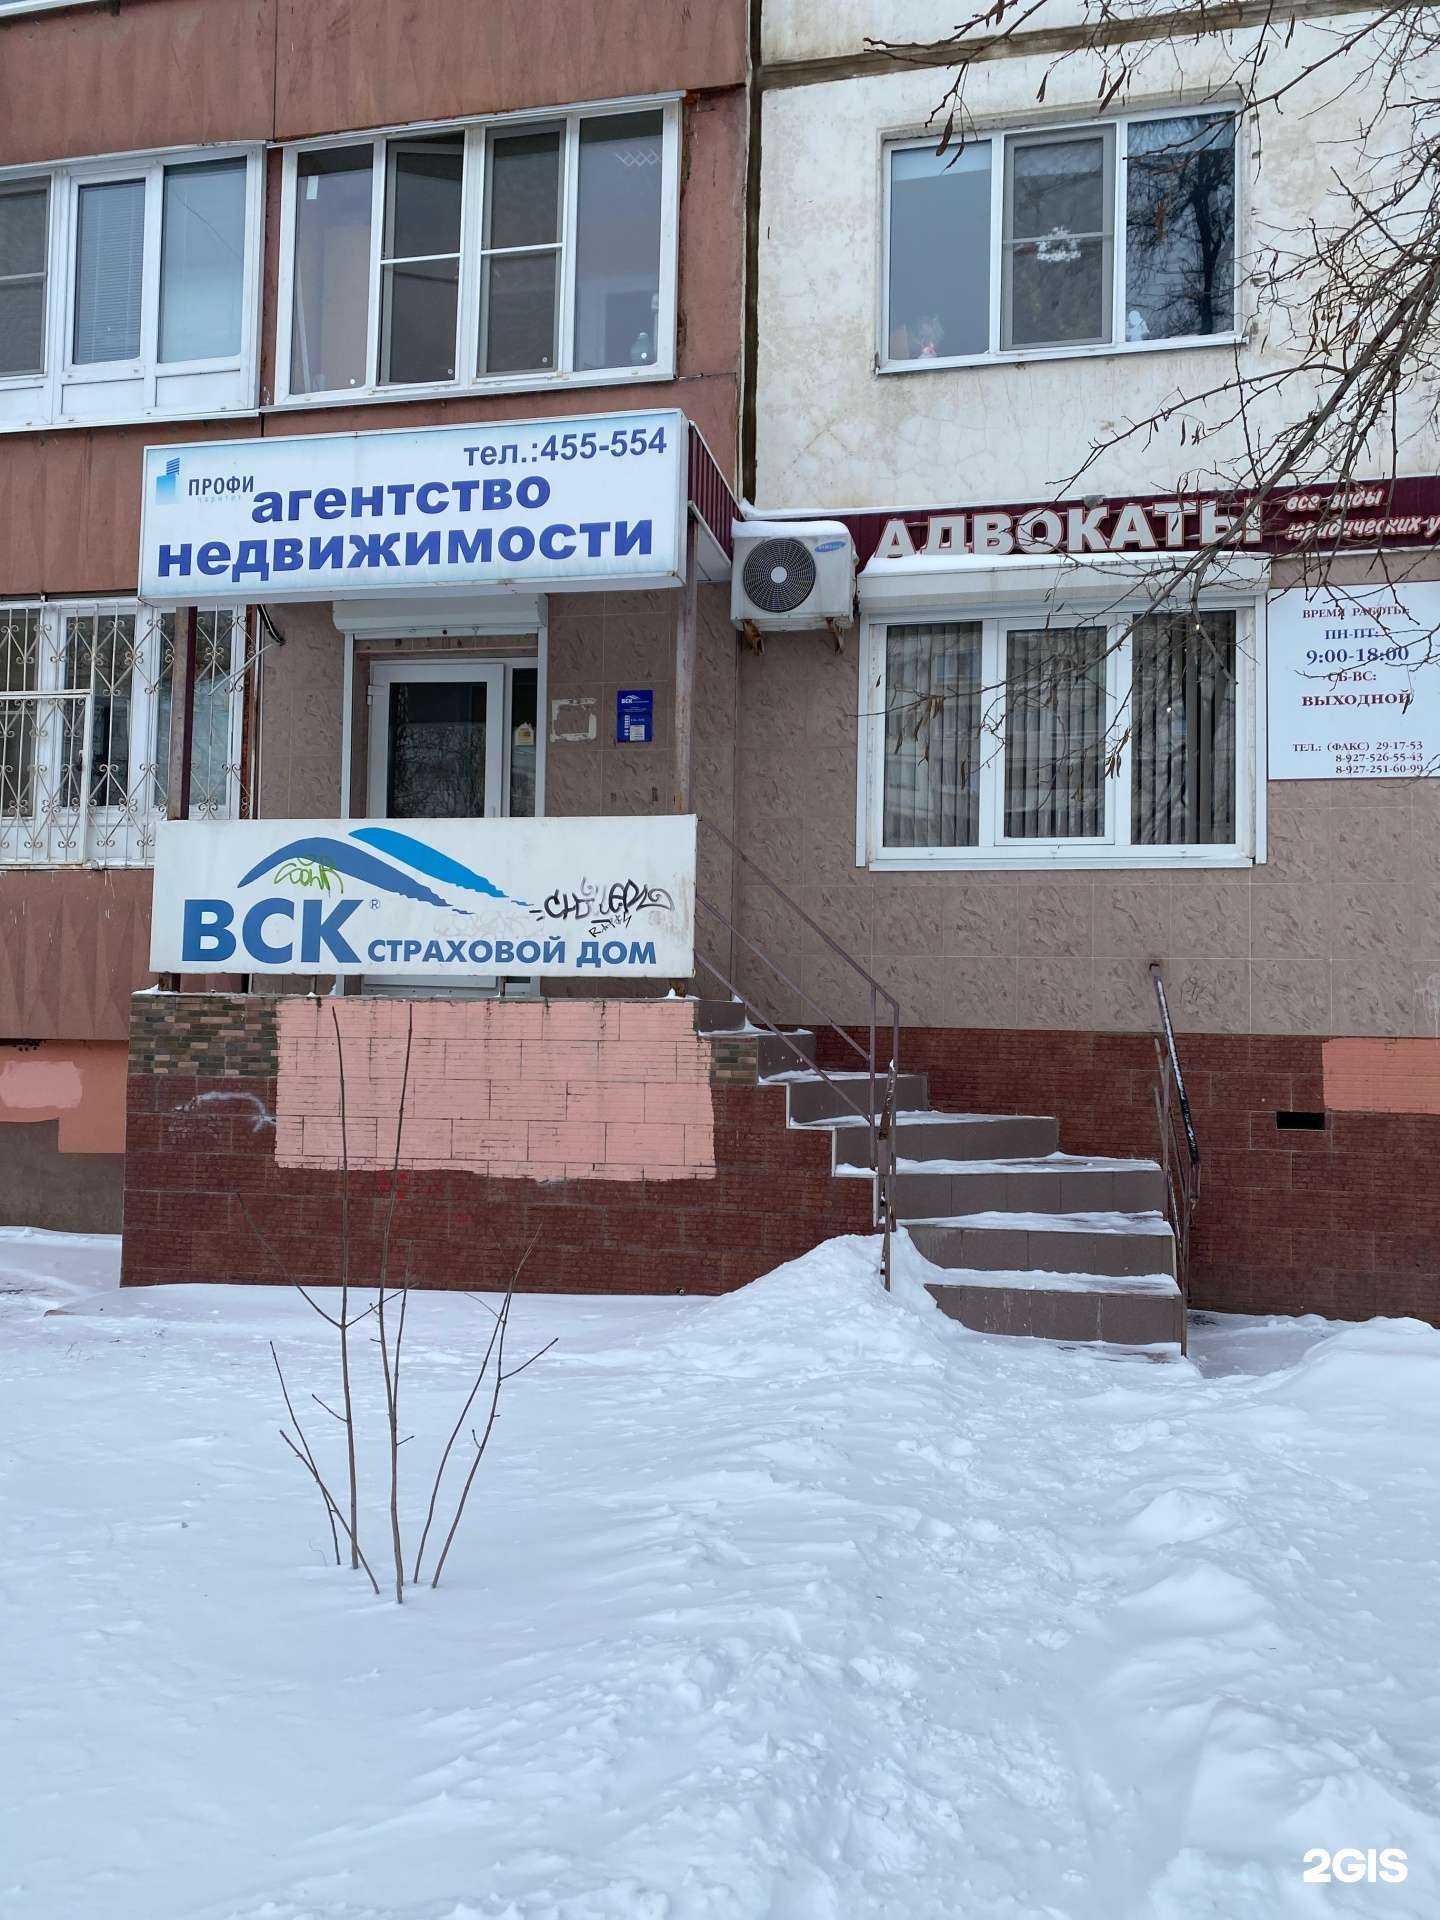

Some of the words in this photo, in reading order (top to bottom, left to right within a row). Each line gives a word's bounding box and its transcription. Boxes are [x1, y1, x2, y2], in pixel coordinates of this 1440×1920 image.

[464, 427, 667, 467] тел.:455-554
[188, 475, 254, 496] ПРОФИ
[251, 474, 552, 523] агентство
[1329, 487, 1385, 511] виды
[874, 496, 1263, 558] АДВОКАТЫ
[157, 518, 654, 583] недвижимости
[1302, 607, 1346, 619] ВРЕМЯ
[1324, 627, 1380, 640] ПН-ПТ:
[1306, 646, 1409, 666] 9:00-18:00
[1327, 670, 1377, 683] СБ-ВС:
[1301, 688, 1411, 708] ВЫХОДНОЙ
[1327, 742, 1370, 752] (ФАКС)
[1376, 741, 1423, 751] 29-17-53
[181, 897, 364, 964] ВСК
[367, 934, 566, 964] СТРАХОВОЙ
[576, 938, 657, 968] ДОМ
